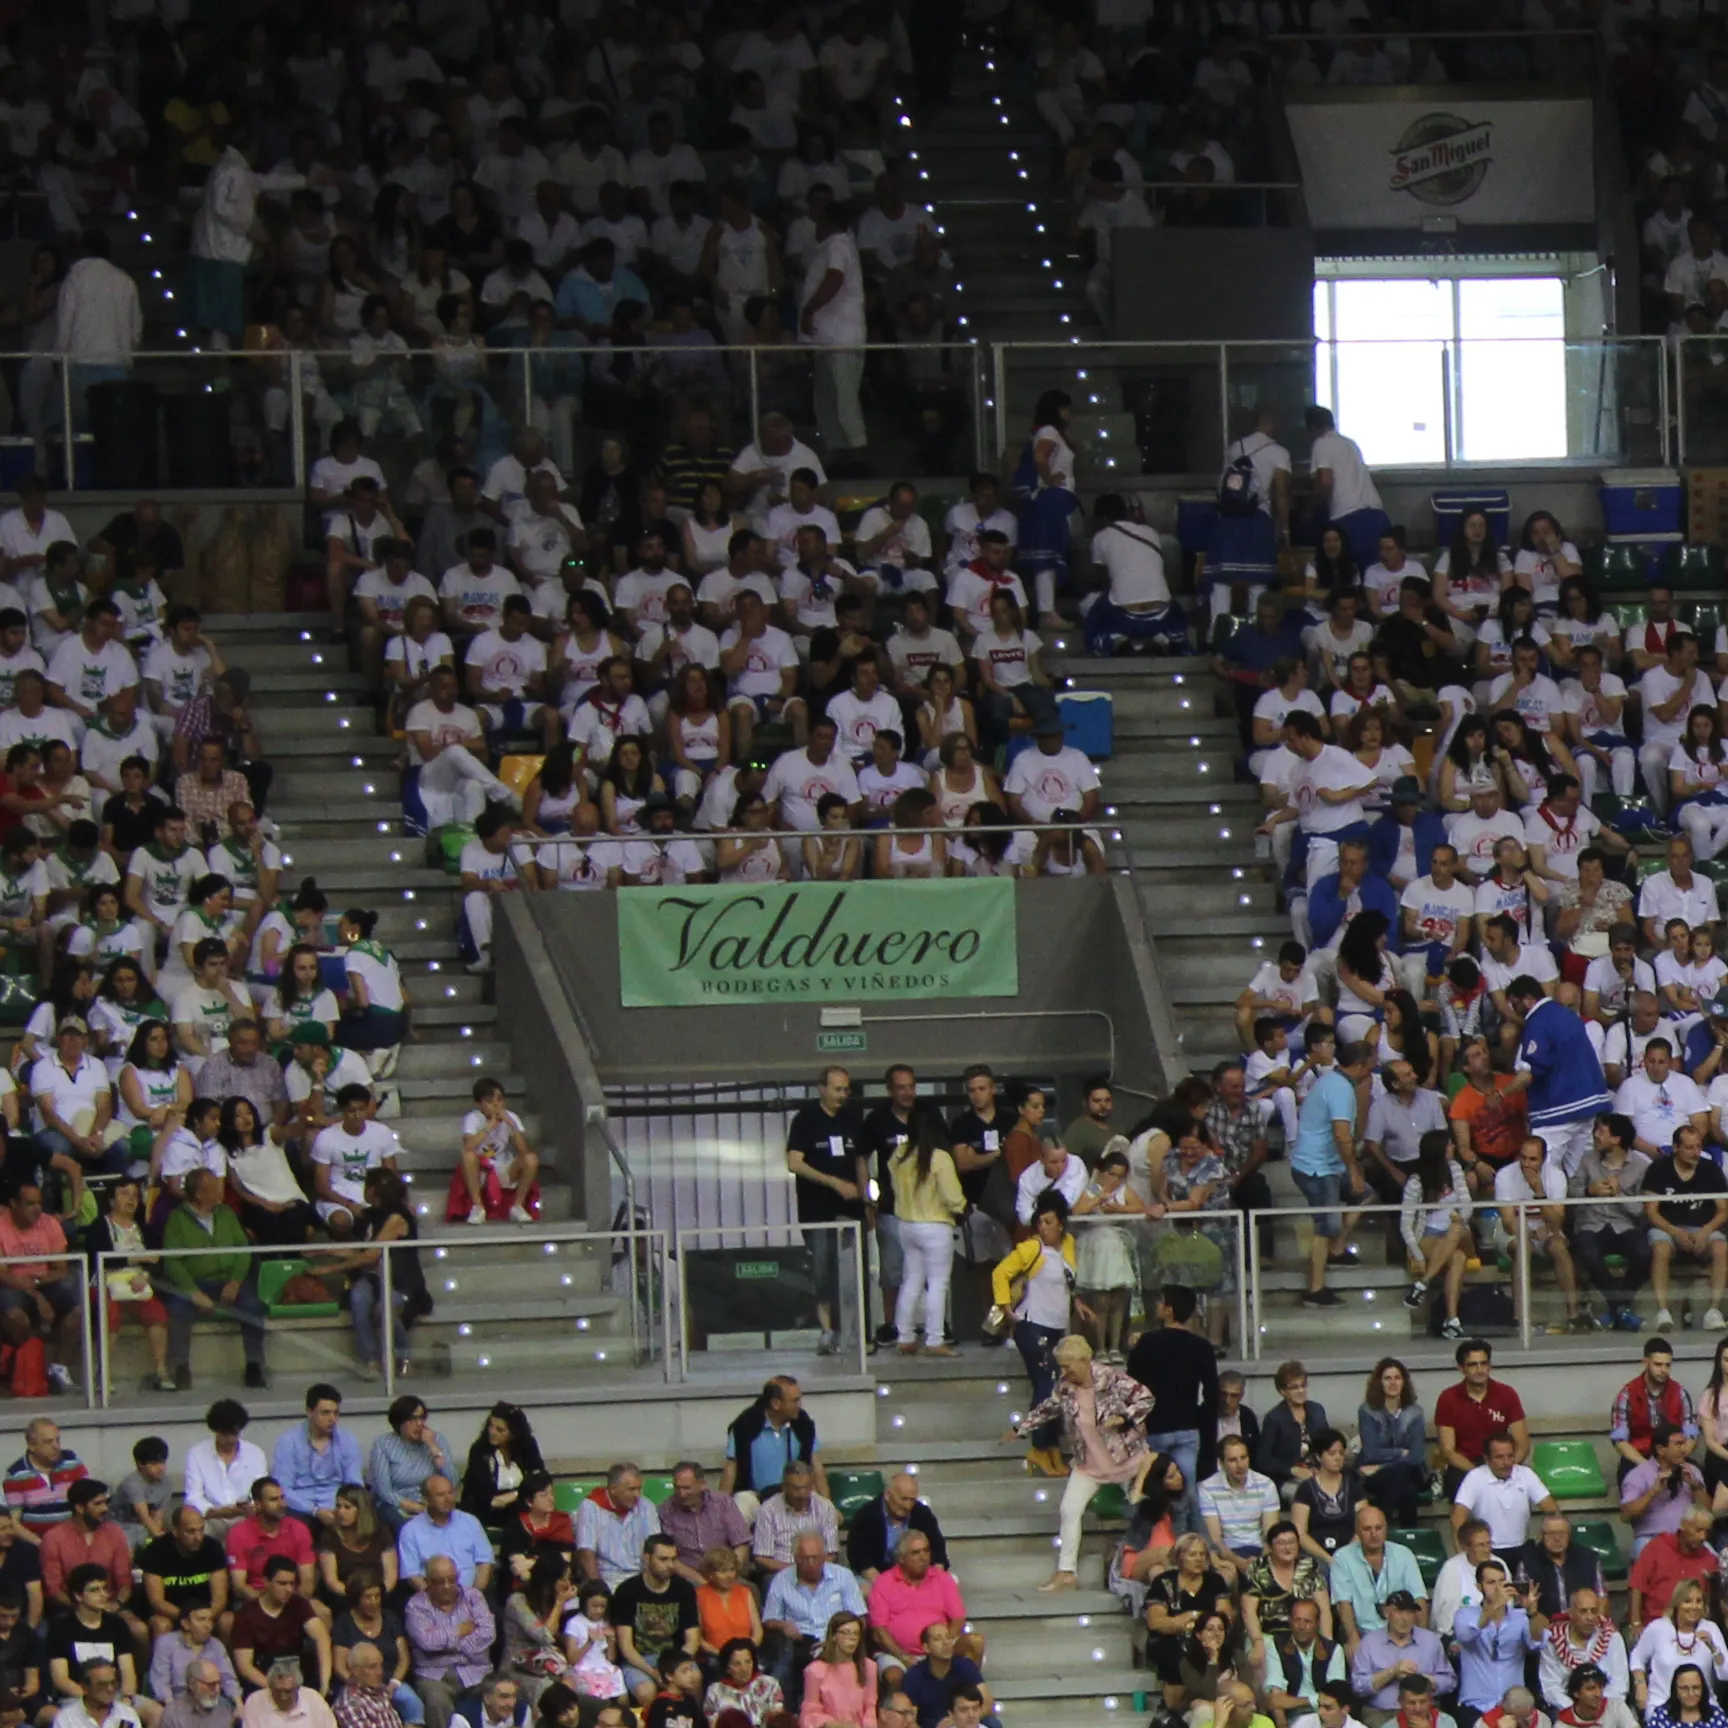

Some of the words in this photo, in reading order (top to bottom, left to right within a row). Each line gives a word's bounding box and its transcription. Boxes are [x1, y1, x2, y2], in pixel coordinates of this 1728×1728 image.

[1391, 155, 1430, 184] San
[1430, 131, 1490, 167] Miguel
[659, 892, 981, 973] Valduero
[703, 976, 812, 994] BODEGAS
[821, 976, 837, 991] Y
[843, 970, 951, 992] VIÑEDOS
